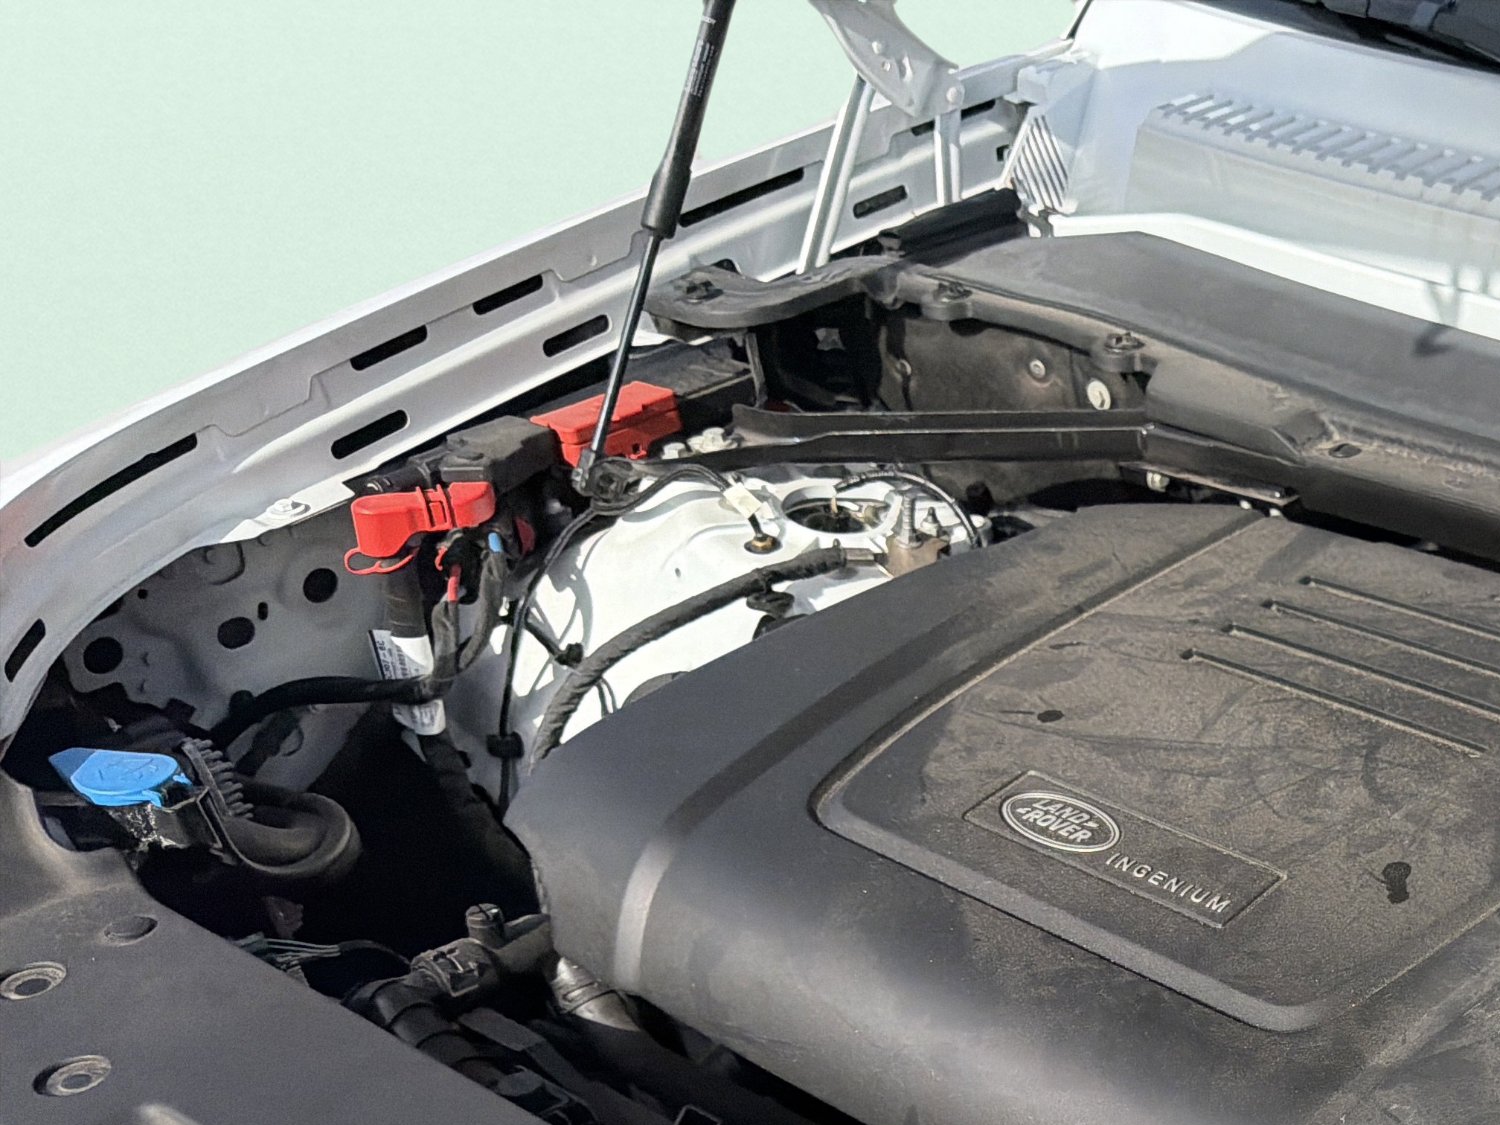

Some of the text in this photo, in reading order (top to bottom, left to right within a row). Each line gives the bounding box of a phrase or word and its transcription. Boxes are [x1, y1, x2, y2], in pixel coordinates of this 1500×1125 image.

[1021, 809, 1092, 842] ROVER
[1032, 800, 1091, 824] LAND
[1105, 853, 1231, 913] INGENIUM
